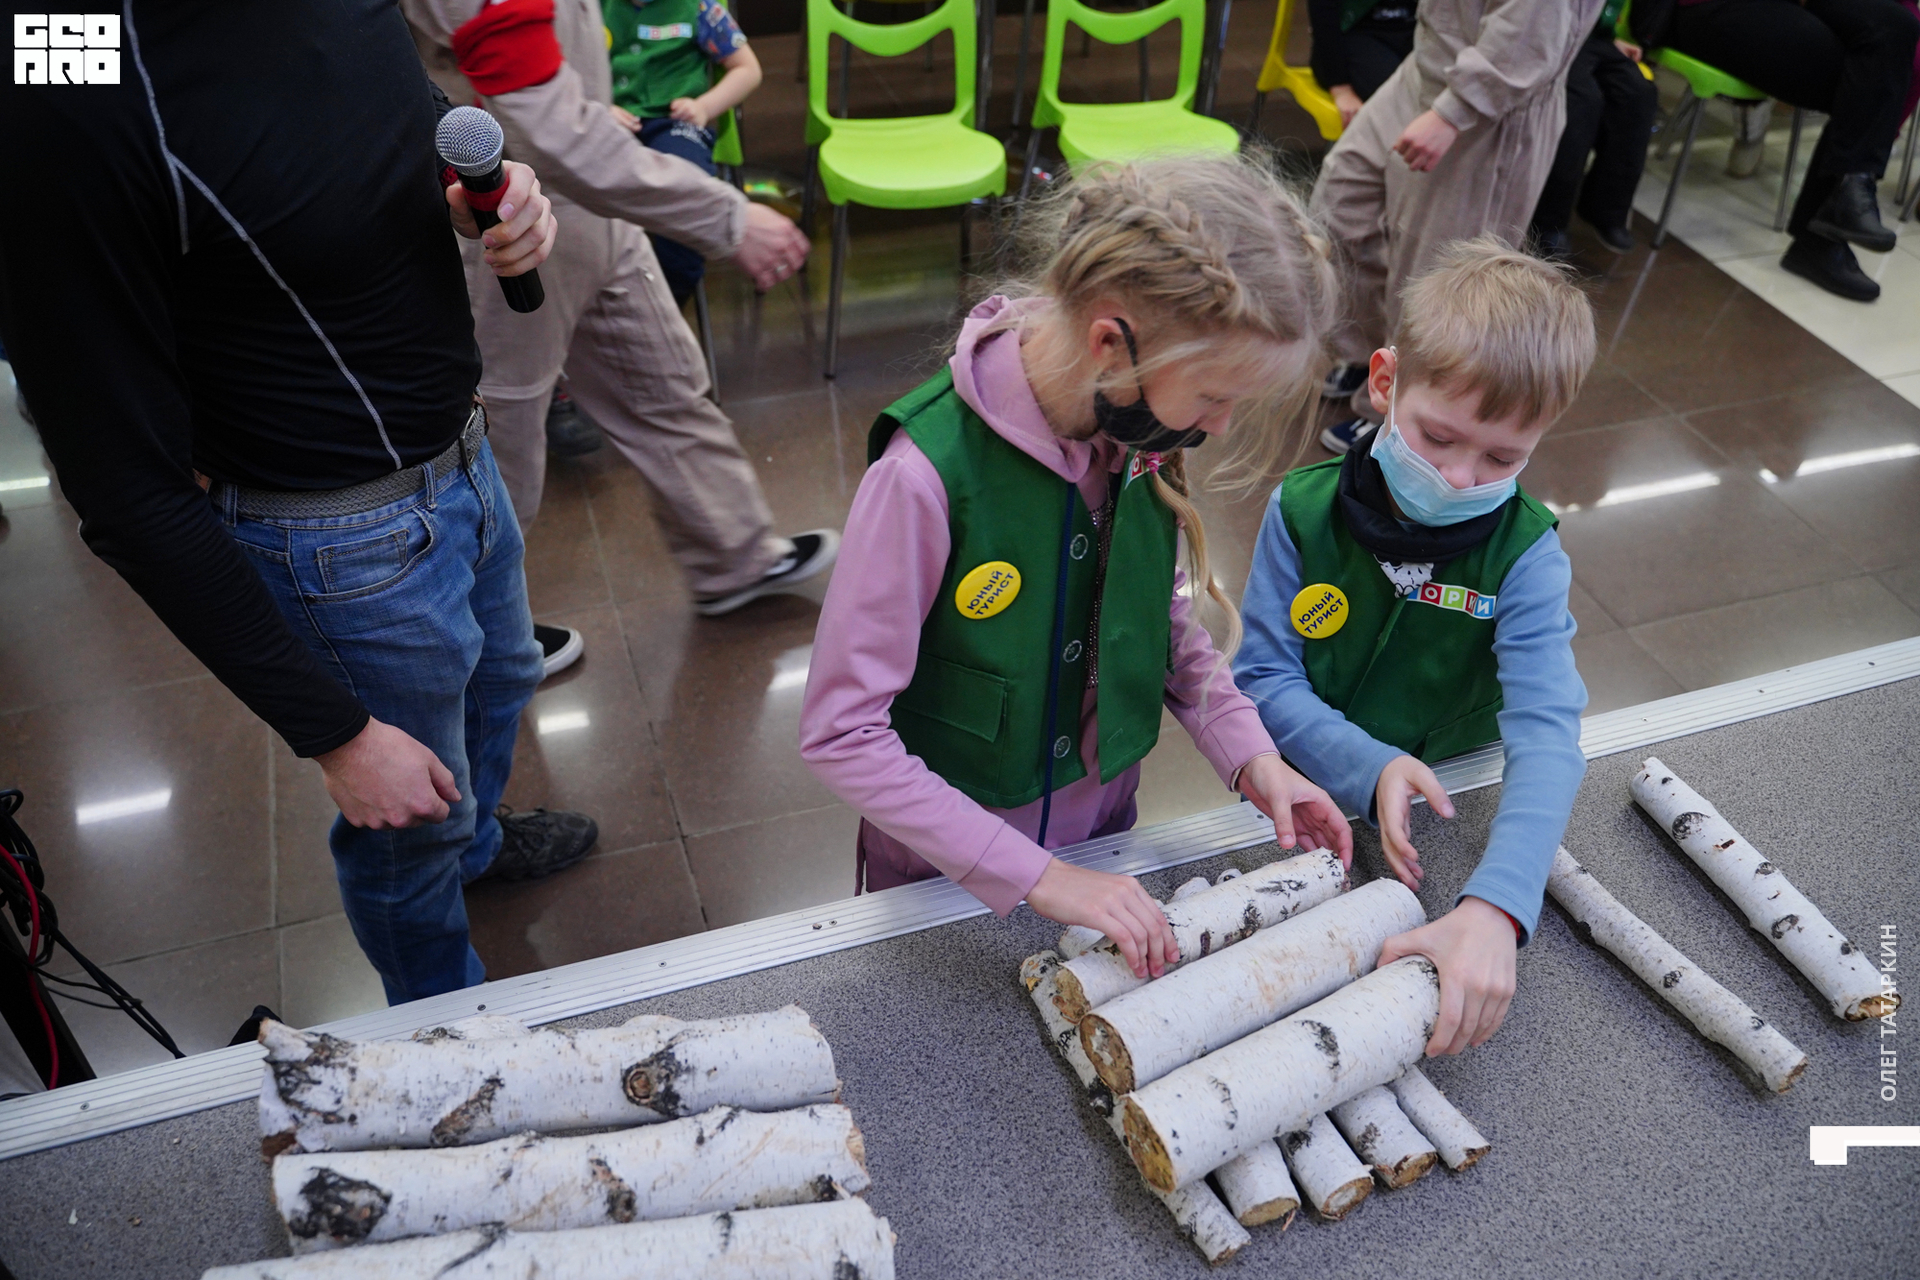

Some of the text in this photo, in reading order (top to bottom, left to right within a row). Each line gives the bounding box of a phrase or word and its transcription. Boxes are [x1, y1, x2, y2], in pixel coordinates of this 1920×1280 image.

[967, 571, 1003, 610] ЮНЫЙ
[975, 573, 1014, 615] ТУРИСТ
[1298, 591, 1335, 625] ЮНЫЙ
[1408, 583, 1493, 617] ОРКИ
[1304, 598, 1343, 634] ТУРИСТ
